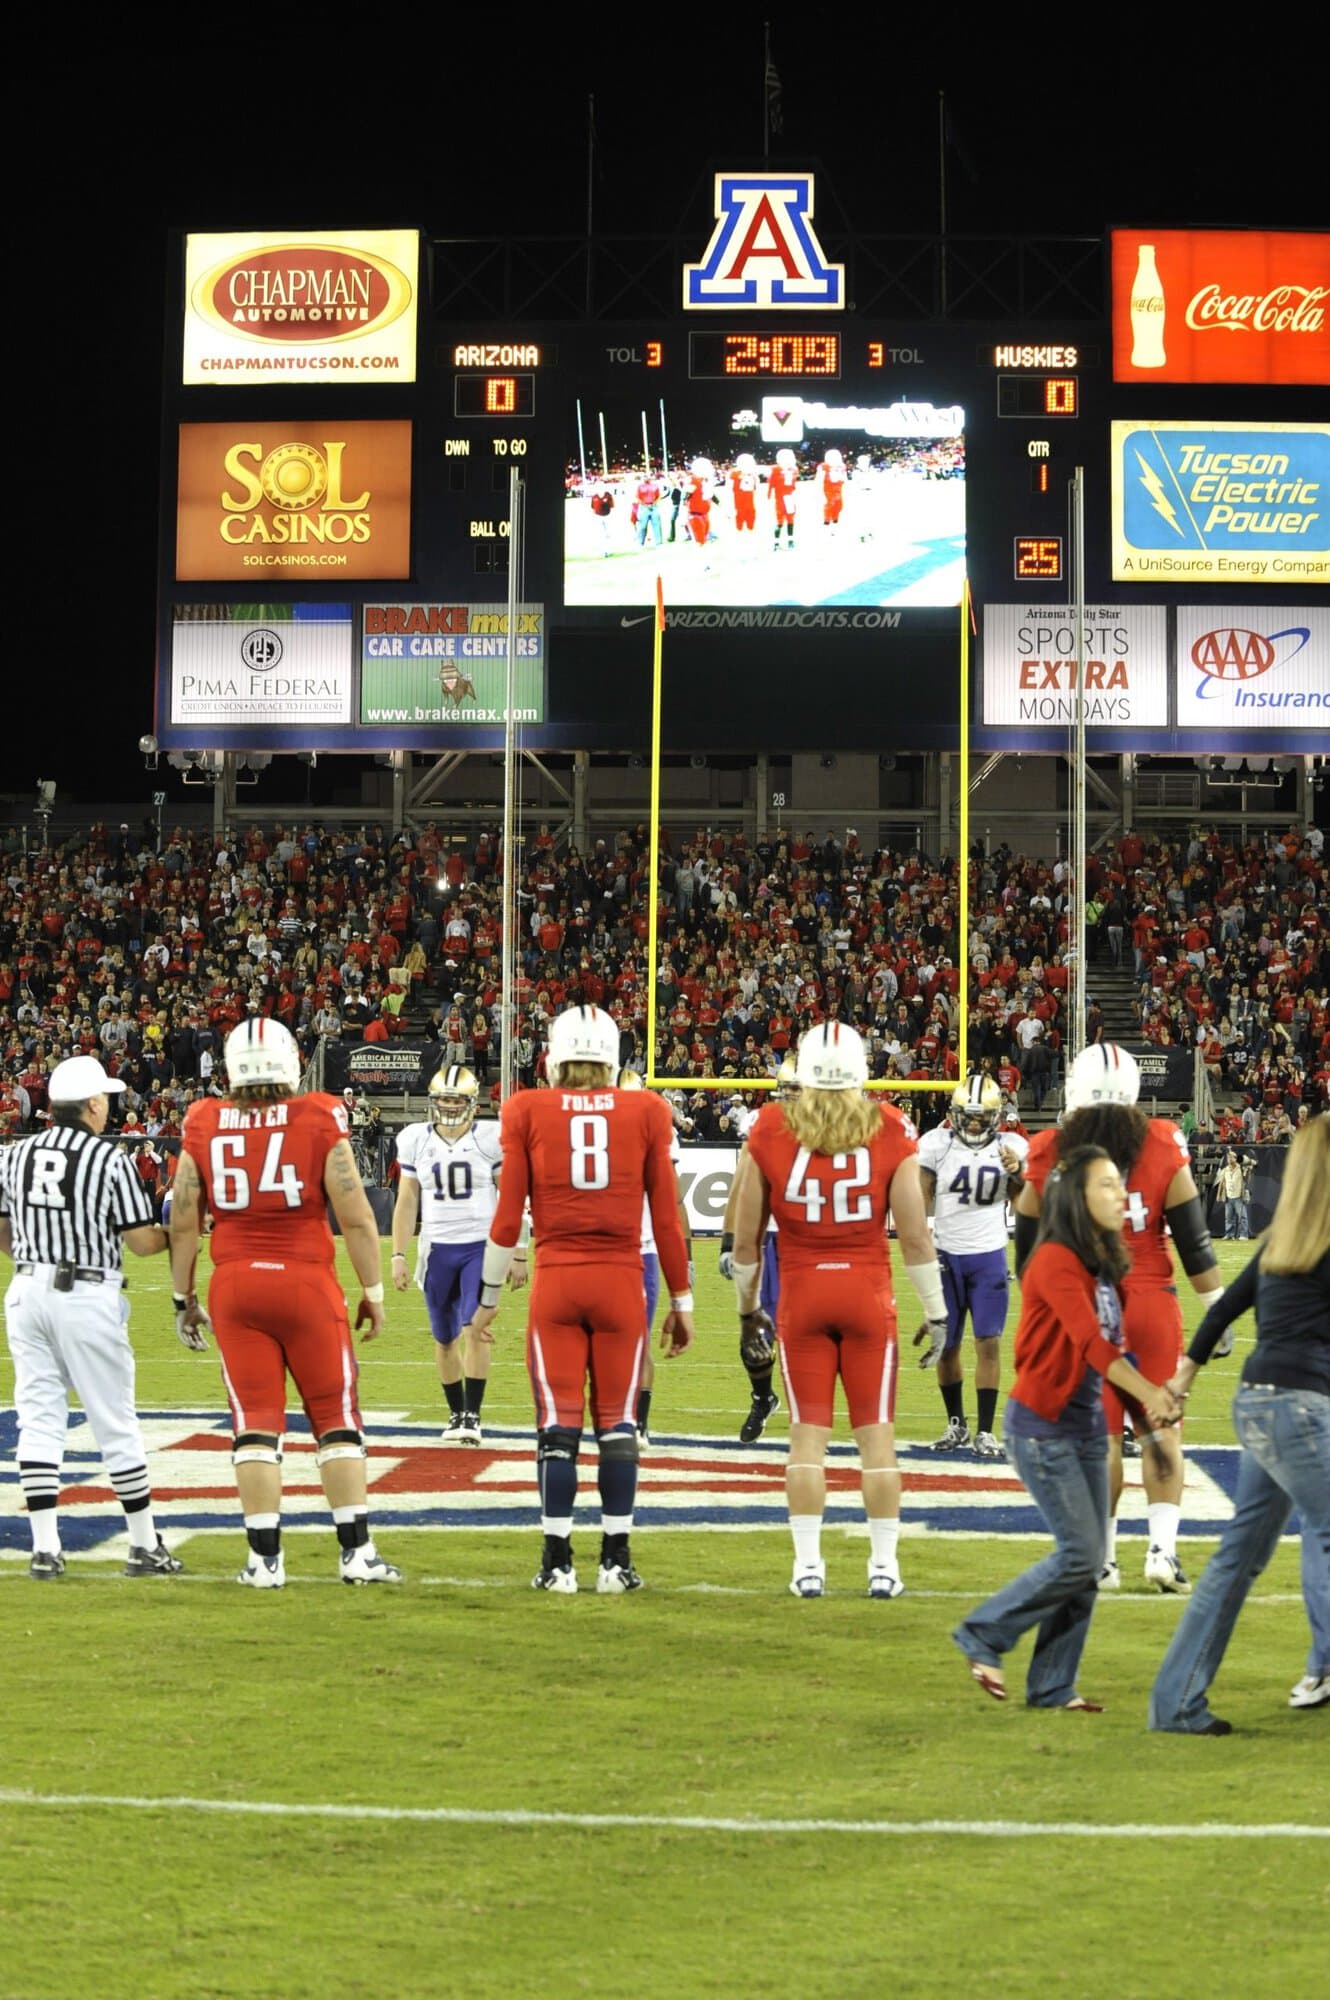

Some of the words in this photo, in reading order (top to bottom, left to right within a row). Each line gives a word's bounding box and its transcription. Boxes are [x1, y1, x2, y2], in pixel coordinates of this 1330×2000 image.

[228, 268, 372, 307] CHAPMAN
[232, 307, 369, 322] AUTOMOTIVE
[1185, 284, 1330, 332] Coca-Cola
[200, 356, 399, 370] CHAPMANTUCSON.COM
[455, 345, 539, 366] ARIZONA
[607, 348, 642, 363] TOL
[647, 343, 661, 366] 3
[726, 336, 836, 373] 2:09
[868, 343, 883, 367] 3
[889, 348, 924, 363] TOL
[996, 346, 1078, 368] HUSKIES
[487, 379, 515, 412] 0
[1046, 380, 1075, 412] 0
[445, 440, 469, 455] DWN
[493, 440, 507, 455] TO
[510, 439, 527, 455] GO
[1028, 441, 1049, 457] QTR
[1179, 445, 1289, 475] Tucson
[221, 442, 370, 511] SOL
[1190, 475, 1320, 504] Electric
[220, 513, 371, 543] CASINOS
[470, 521, 496, 537] BALL
[1203, 504, 1320, 534] Power
[243, 555, 347, 566] SOLCASINOS.COM
[1019, 541, 1058, 574] 25
[1124, 559, 1134, 570] A
[1139, 558, 1213, 571] UniSource
[1218, 559, 1268, 574] Energy
[663, 611, 901, 629] ARIZONAWILDCATS.COM
[1025, 608, 1066, 620] Arizona
[1069, 608, 1097, 622] Dily
[1098, 608, 1121, 620] Star
[368, 638, 404, 656] CAR
[410, 638, 455, 656] CARE
[462, 638, 538, 656] CENTRS
[1017, 627, 1129, 655] SPORTS
[1197, 629, 1270, 680] AAA
[181, 675, 238, 696] PIMA
[250, 675, 342, 696] FEDERAL
[1019, 660, 1129, 690] EXTRA
[214, 703, 244, 711] UNION
[1020, 698, 1131, 720] MONDAYS
[154, 791, 166, 806] 27
[772, 792, 786, 807] 28
[351, 1054, 391, 1062] AMERICAN
[393, 1055, 421, 1063] FAMILY
[1140, 1059, 1167, 1067] FAMILY
[1233, 1051, 1248, 1063] 32
[570, 1114, 610, 1190] 8
[28, 1148, 68, 1208] R
[210, 1131, 304, 1210] 64
[431, 1162, 473, 1200] 10
[785, 1147, 872, 1223] 42
[950, 1166, 1001, 1206] 40
